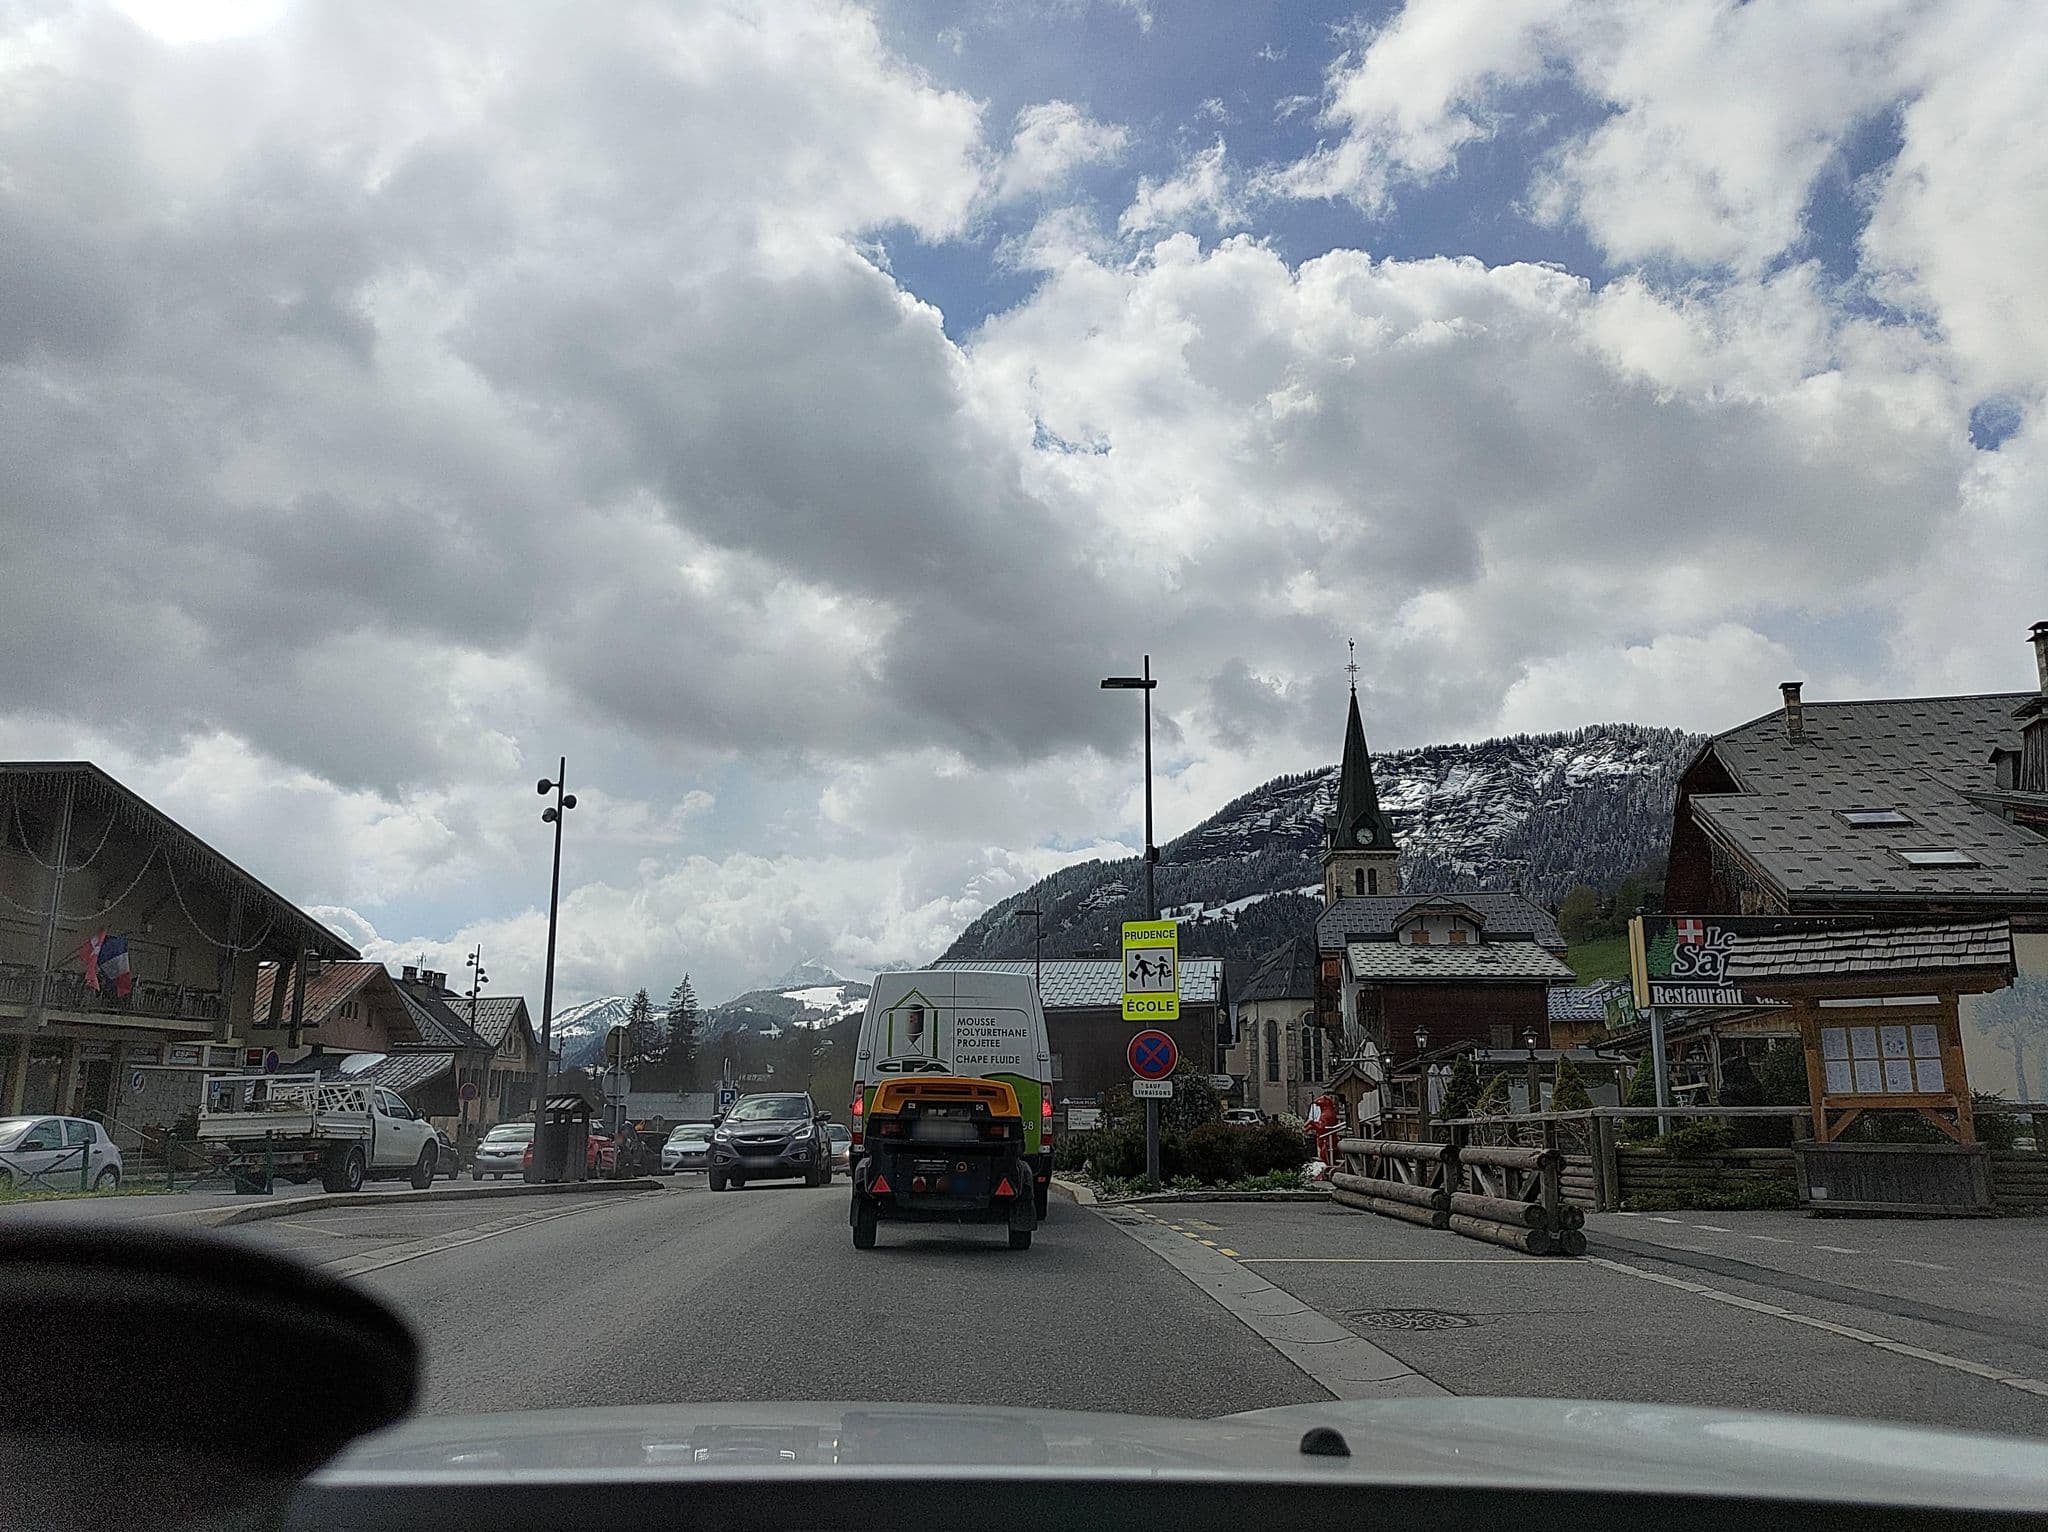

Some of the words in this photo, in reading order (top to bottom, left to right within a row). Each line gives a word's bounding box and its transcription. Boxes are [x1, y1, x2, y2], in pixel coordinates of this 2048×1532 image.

[1124, 929, 1175, 940] PRUDENCE
[1705, 926, 1737, 949] Le
[1653, 986, 1744, 1004] Restaurant
[1127, 999, 1174, 1012] ÉCOLE
[957, 1017, 996, 1026] MOUSSE
[956, 1028, 1028, 1037] POLYURETHANE
[957, 1039, 1001, 1048] PROJETEE
[956, 1055, 989, 1064] CHAPE
[990, 1055, 1021, 1064] FLUIDE
[876, 1061, 951, 1073] CFA
[724, 1092, 731, 1103] P
